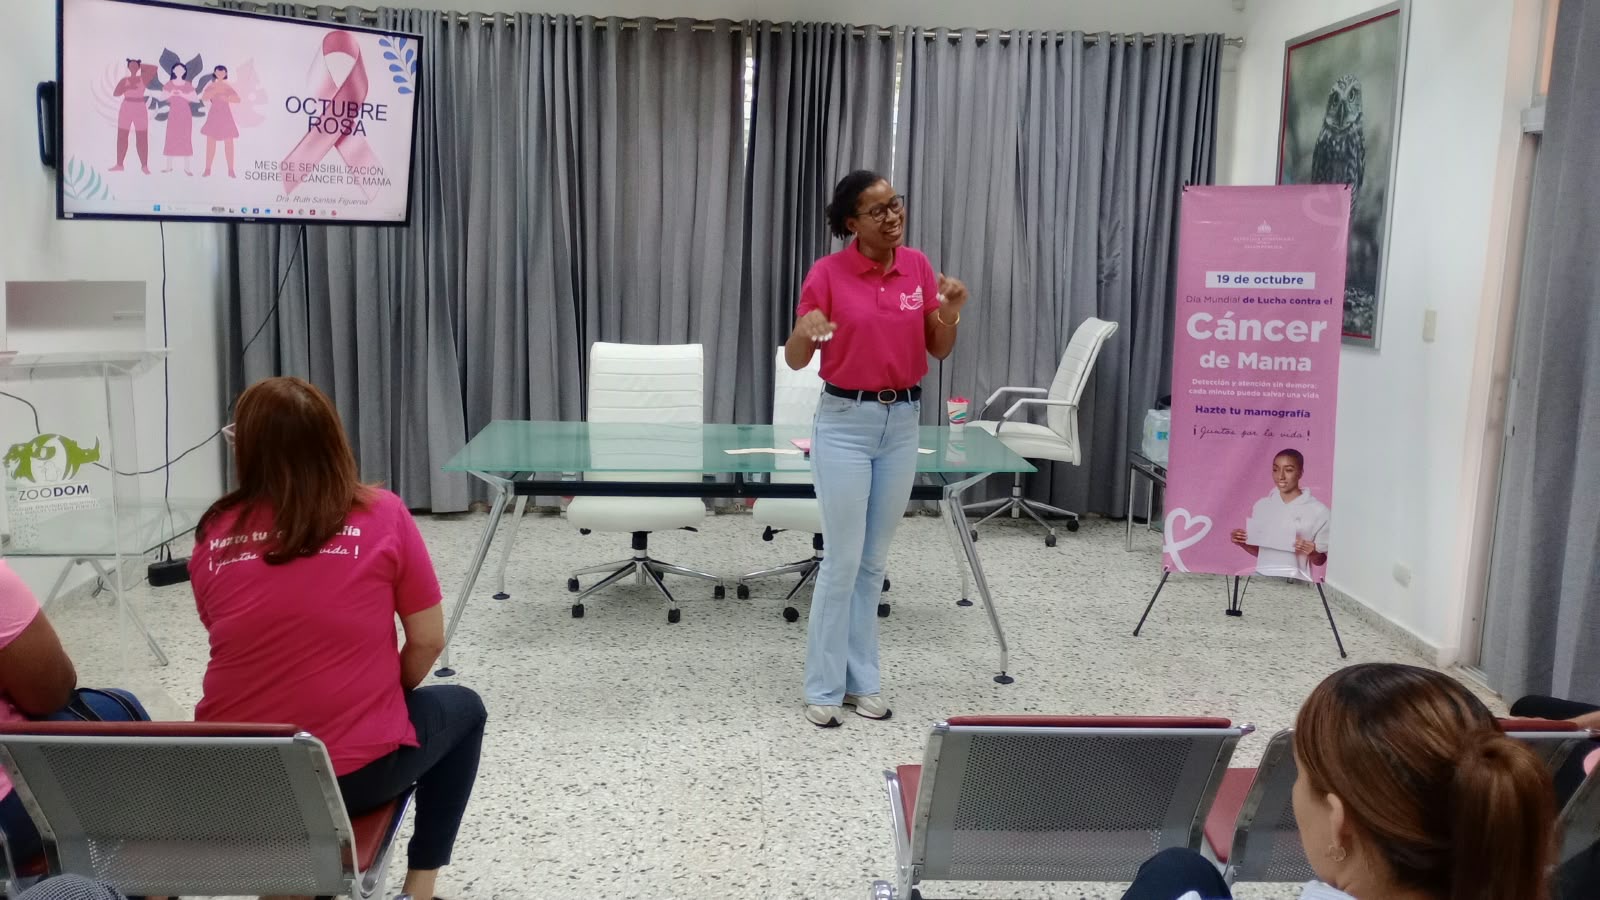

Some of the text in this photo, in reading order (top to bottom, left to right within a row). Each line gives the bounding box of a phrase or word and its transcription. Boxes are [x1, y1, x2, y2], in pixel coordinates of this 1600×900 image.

[285, 96, 388, 121] OCTUBRE
[308, 116, 367, 137] ROSA
[254, 160, 384, 176] MES DE SENSIBILIZACIÓN
[244, 171, 392, 187] SOBRE EL CÁNCER DE MAMA
[1216, 274, 1304, 285] 19 de octubre
[1186, 295, 1200, 303] Día
[1204, 296, 1240, 304] Mundial
[1242, 296, 1255, 304] de
[1257, 297, 1287, 305] Lucha
[1323, 297, 1333, 305] el
[1186, 311, 1328, 342] Cáncer
[1200, 350, 1312, 372] de Mama
[1191, 378, 1230, 387] Detección
[1238, 380, 1271, 388] atención
[1188, 387, 1207, 395] cada
[1208, 388, 1235, 396] minuto
[1236, 389, 1261, 398] puede
[1262, 390, 1285, 398] salvar
[1303, 391, 1320, 399] vida
[1195, 405, 1311, 419] Hazte tu mamografía
[1241, 430, 1258, 438] por
[1264, 428, 1275, 437] la
[19, 484, 90, 501] ZOODOM
[252, 531, 267, 542] tu
